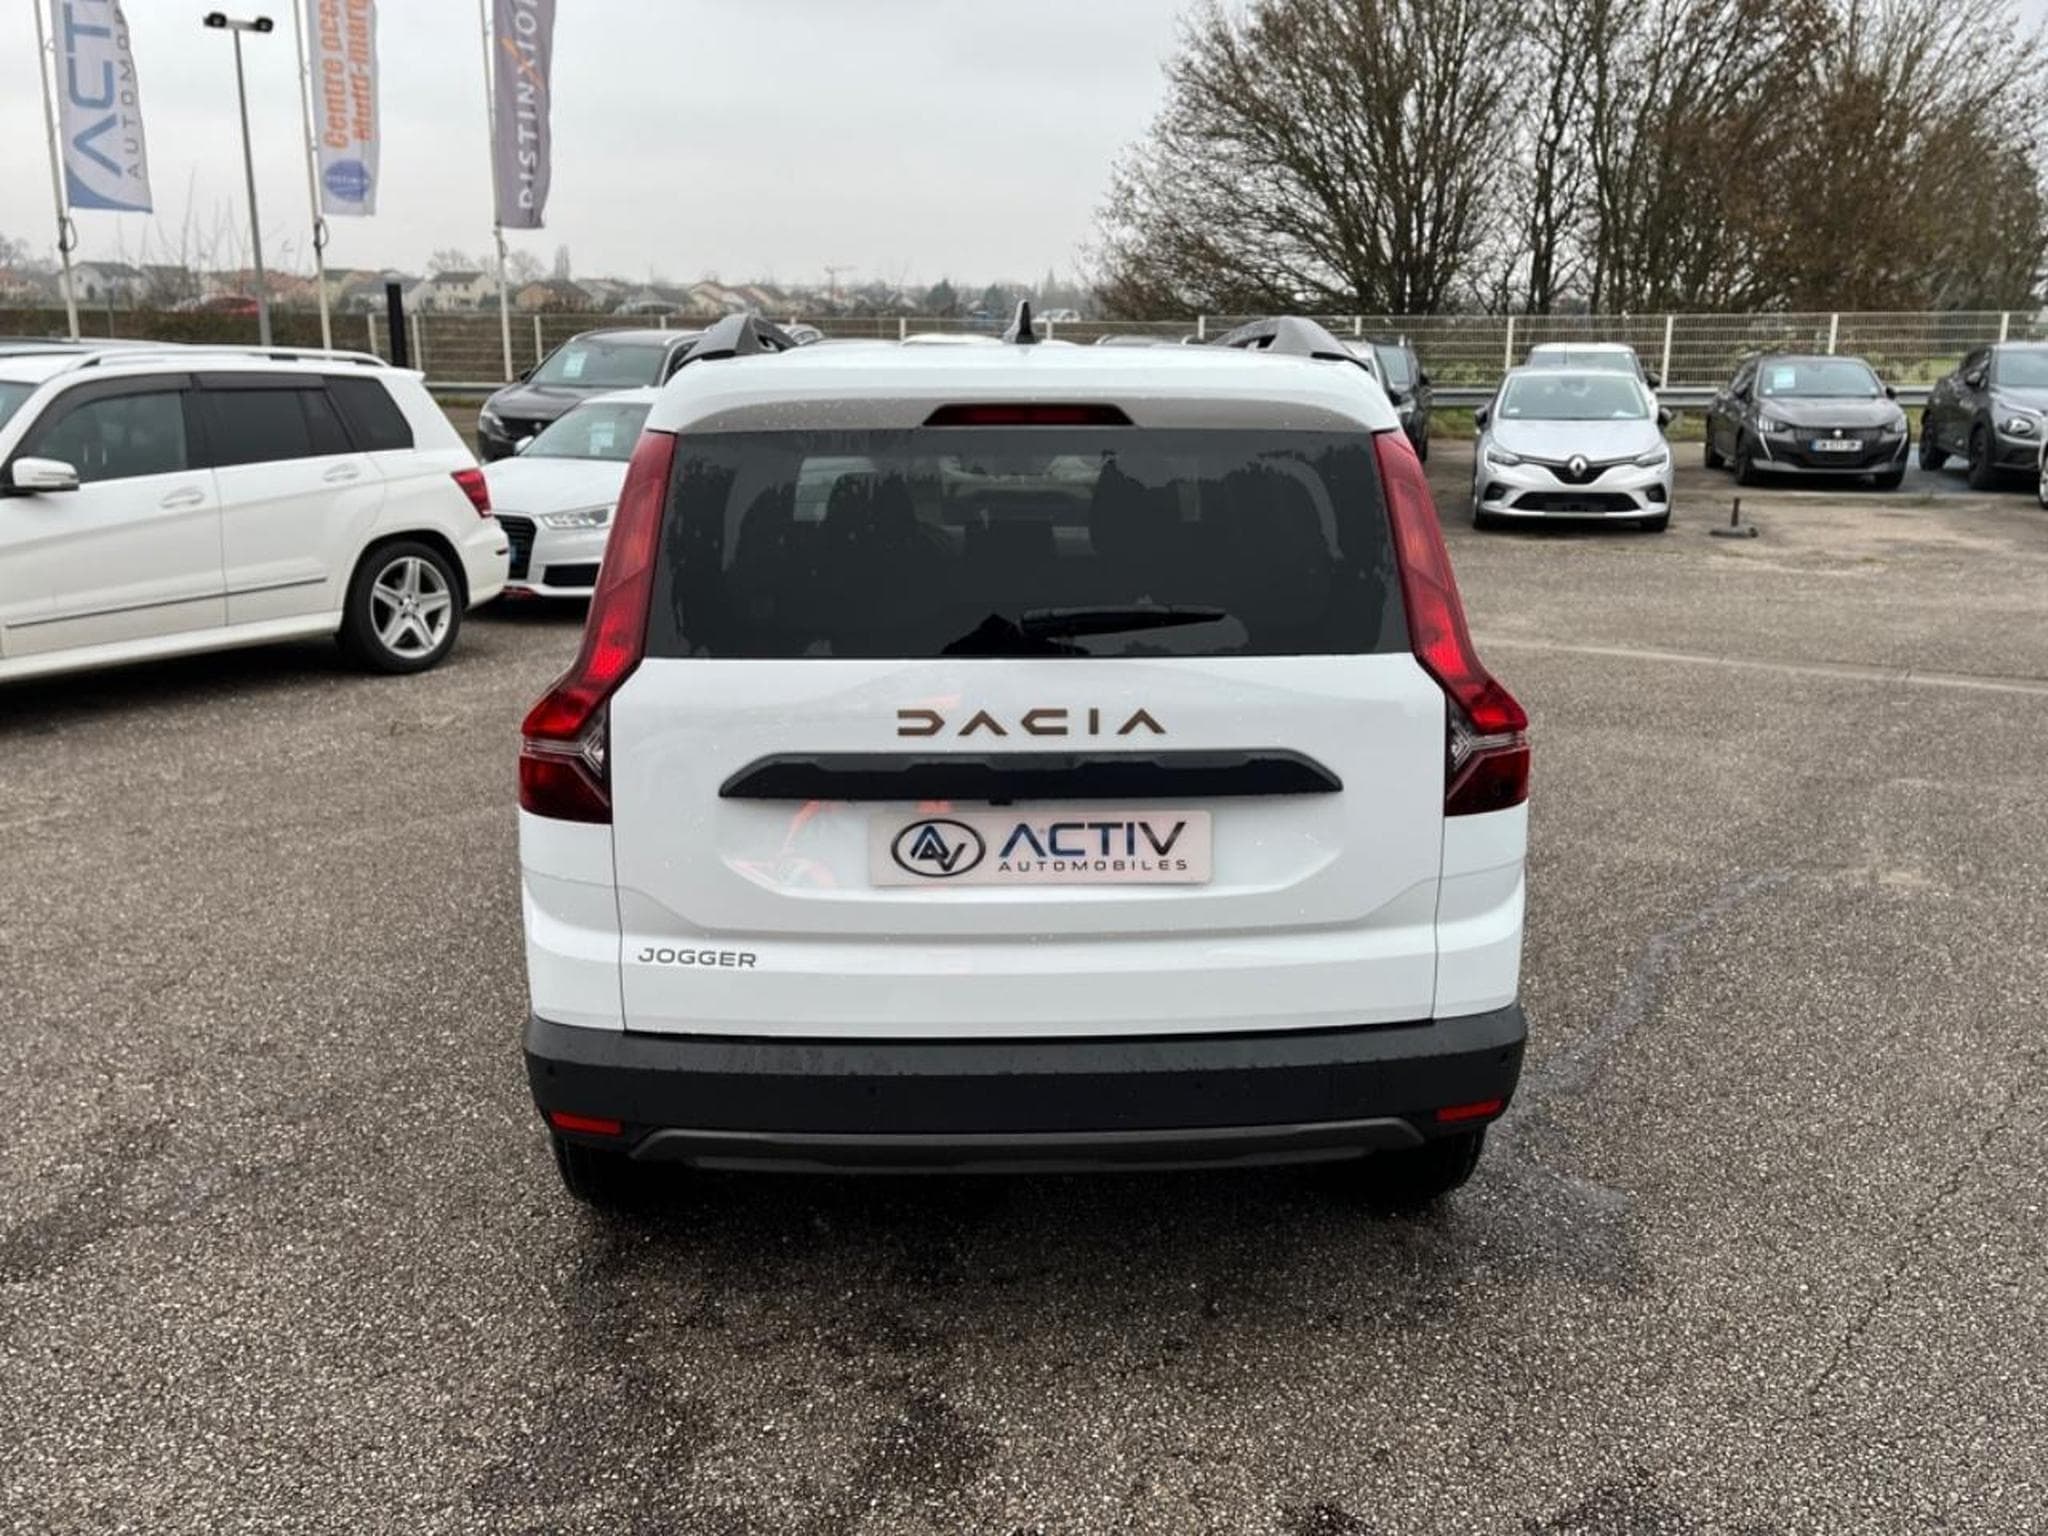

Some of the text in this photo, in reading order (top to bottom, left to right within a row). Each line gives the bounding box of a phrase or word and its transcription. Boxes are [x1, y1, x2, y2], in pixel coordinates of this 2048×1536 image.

[63, 0, 122, 178] ACT
[897, 708, 1167, 736] DACIA
[999, 821, 1187, 858] ACTIV
[998, 859, 1188, 873] AUTOMOBILES
[638, 947, 757, 968] JOGGER
